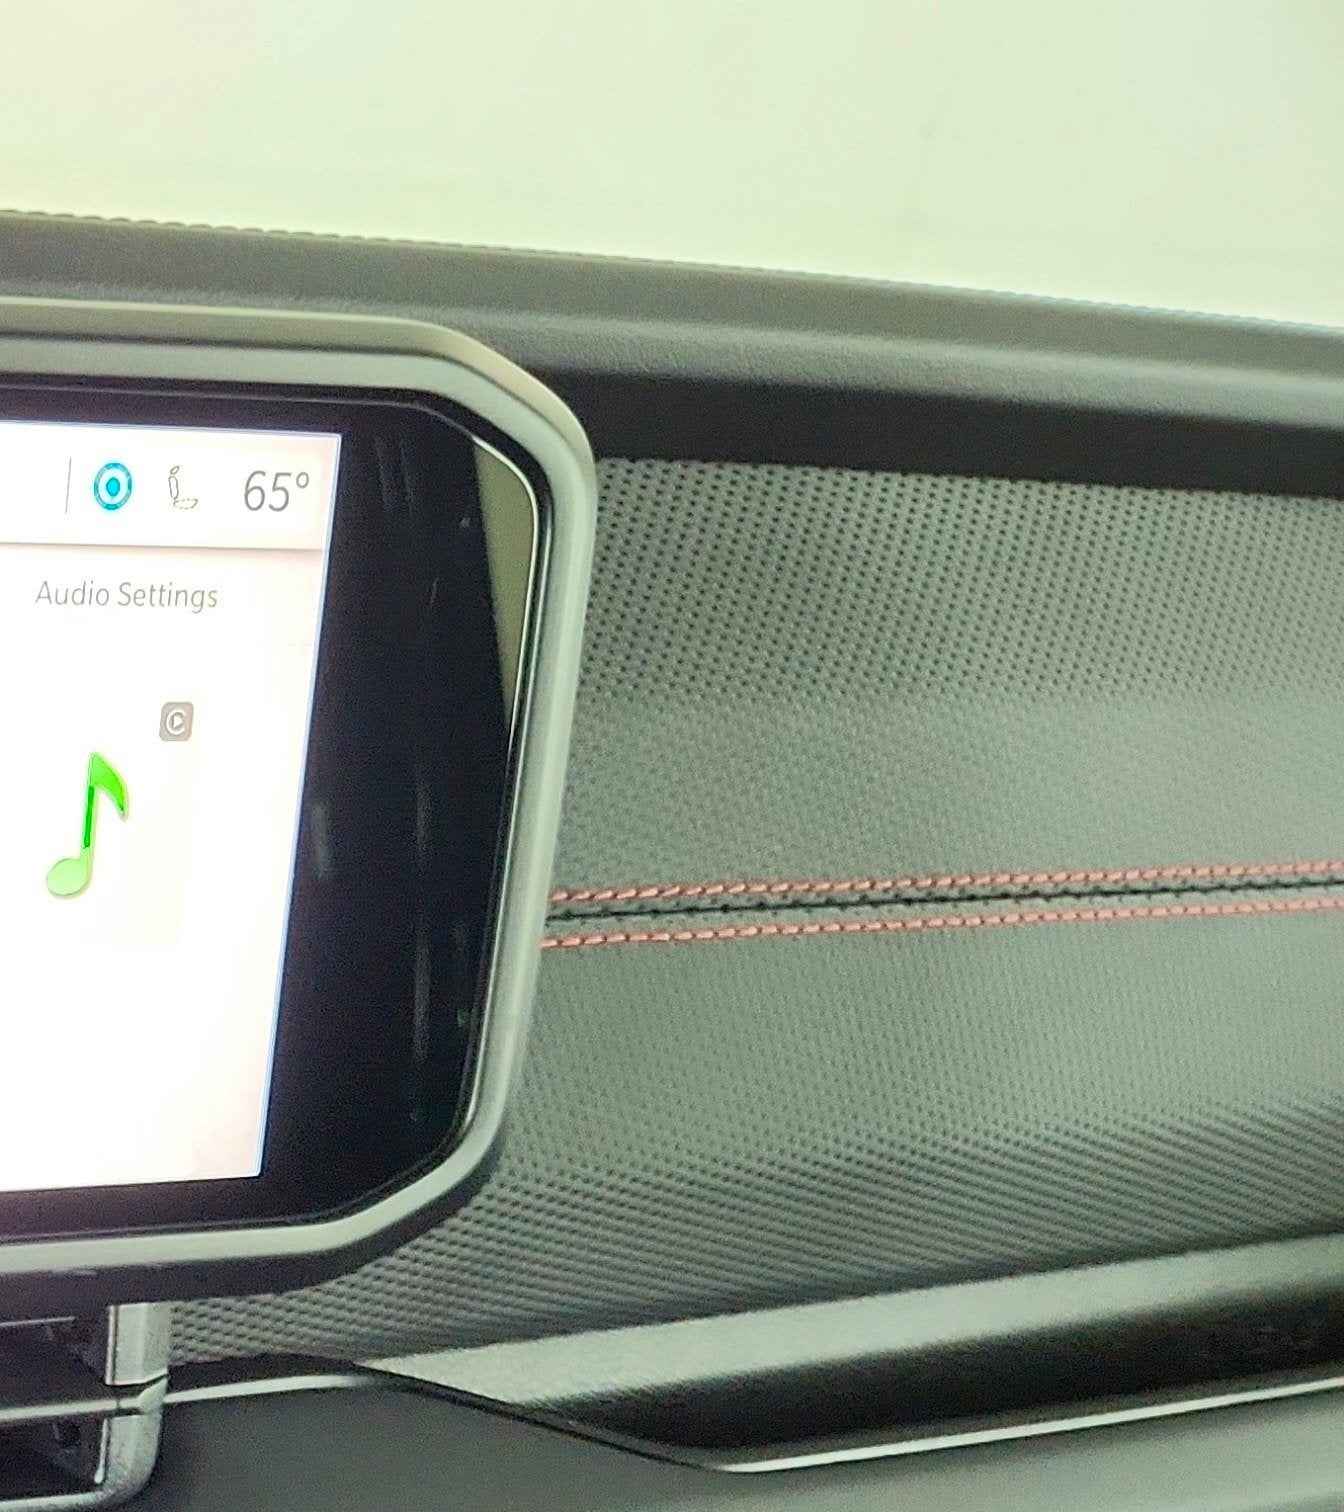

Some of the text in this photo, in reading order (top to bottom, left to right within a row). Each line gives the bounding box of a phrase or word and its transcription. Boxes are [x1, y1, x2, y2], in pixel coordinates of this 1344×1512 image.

[242, 471, 310, 512] 65°
[35, 581, 219, 614] Audio Settings
